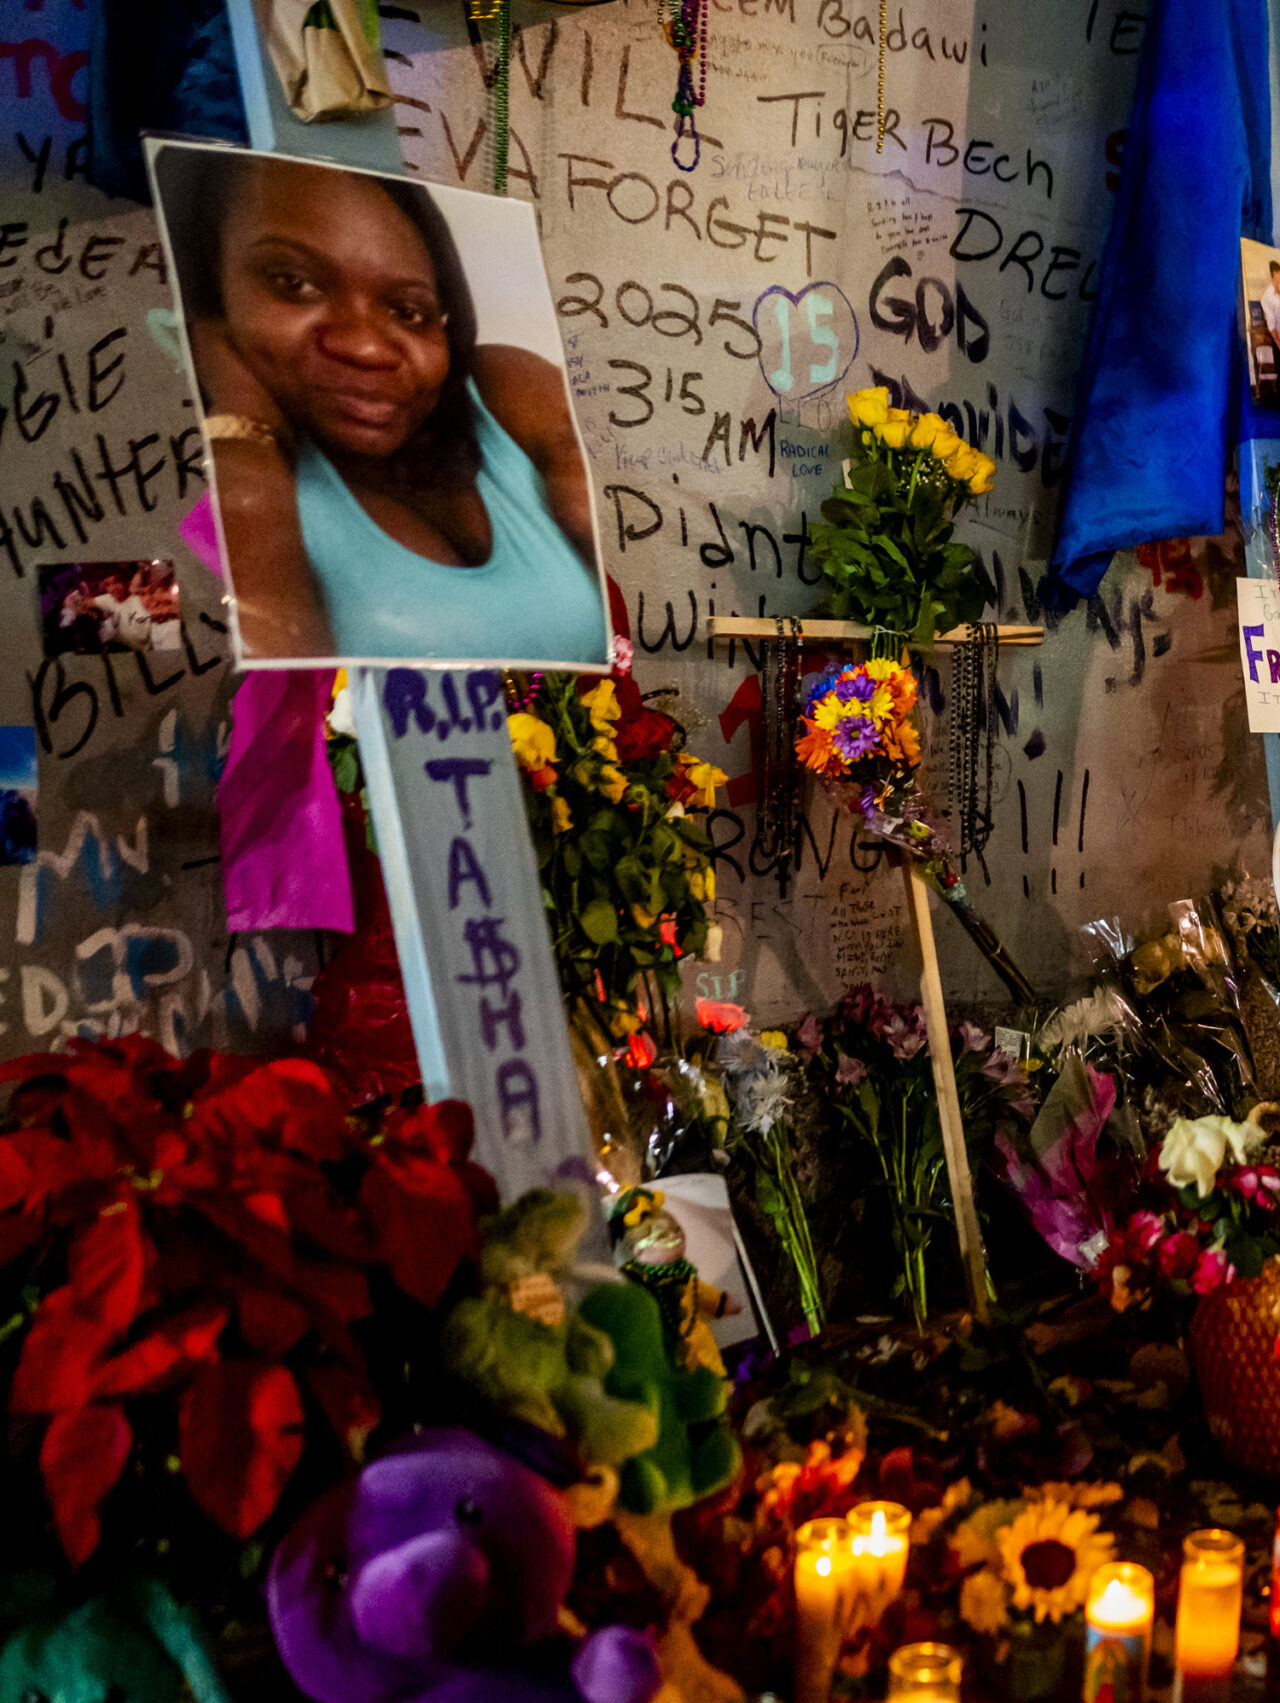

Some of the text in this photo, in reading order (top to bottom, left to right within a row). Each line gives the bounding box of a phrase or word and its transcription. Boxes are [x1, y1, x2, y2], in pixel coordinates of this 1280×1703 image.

[817, 0, 988, 67] Badawi
[558, 153, 836, 278] FORGET
[556, 272, 763, 359] 2025
[869, 257, 990, 363] GOD
[702, 408, 777, 478] AM
[780, 439, 830, 459] RADICAL
[792, 463, 823, 478] LOVE
